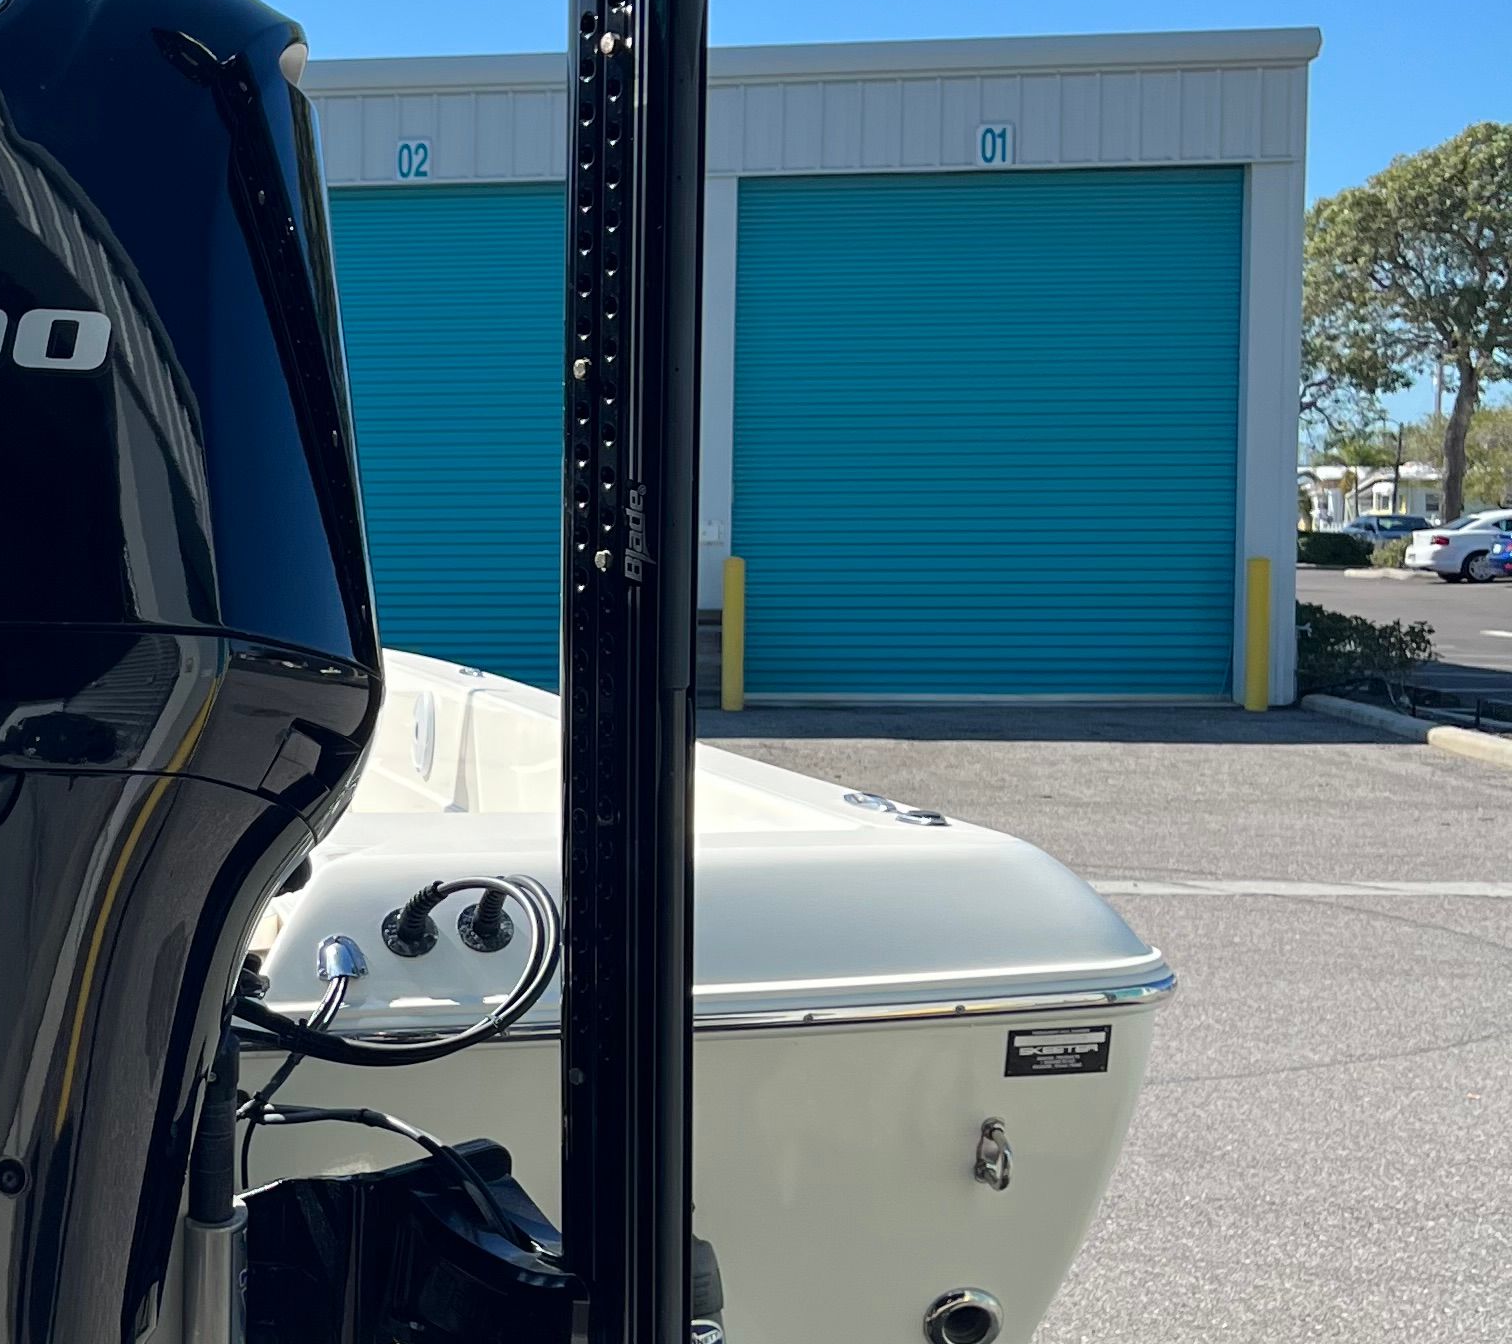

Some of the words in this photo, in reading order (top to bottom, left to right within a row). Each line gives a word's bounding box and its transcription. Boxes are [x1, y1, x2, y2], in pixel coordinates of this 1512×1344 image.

[398, 143, 428, 178] 02
[981, 127, 1007, 163] 01
[624, 489, 656, 582] Blade
[1019, 1044, 1098, 1055] SKEETER
